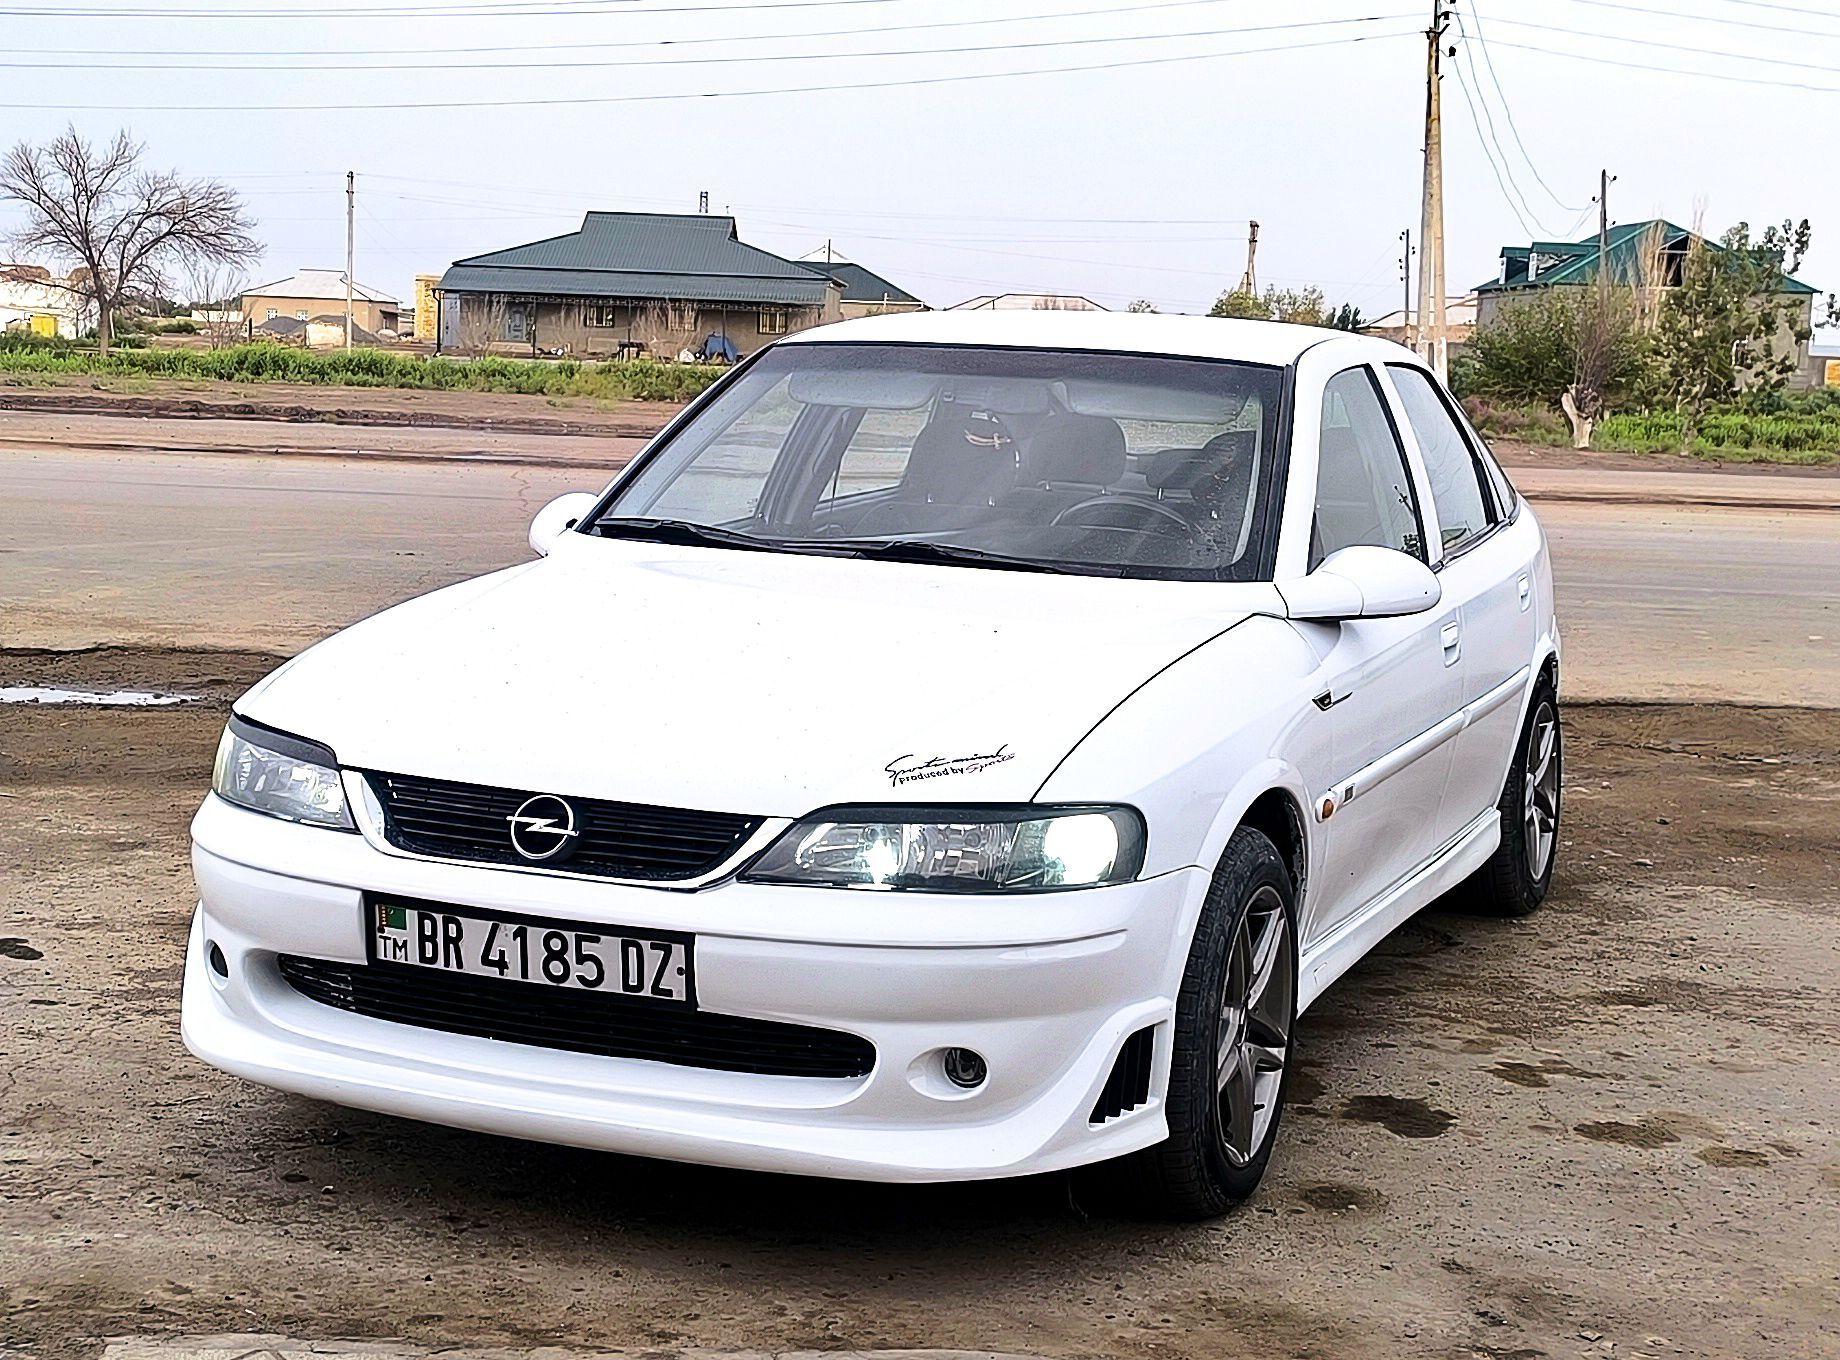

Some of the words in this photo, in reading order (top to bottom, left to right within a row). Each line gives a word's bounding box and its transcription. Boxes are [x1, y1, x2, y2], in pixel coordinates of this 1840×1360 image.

[378, 934, 409, 963] TM
[417, 911, 464, 970] BR
[480, 922, 605, 988] 4185
[620, 938, 674, 998] DZ
